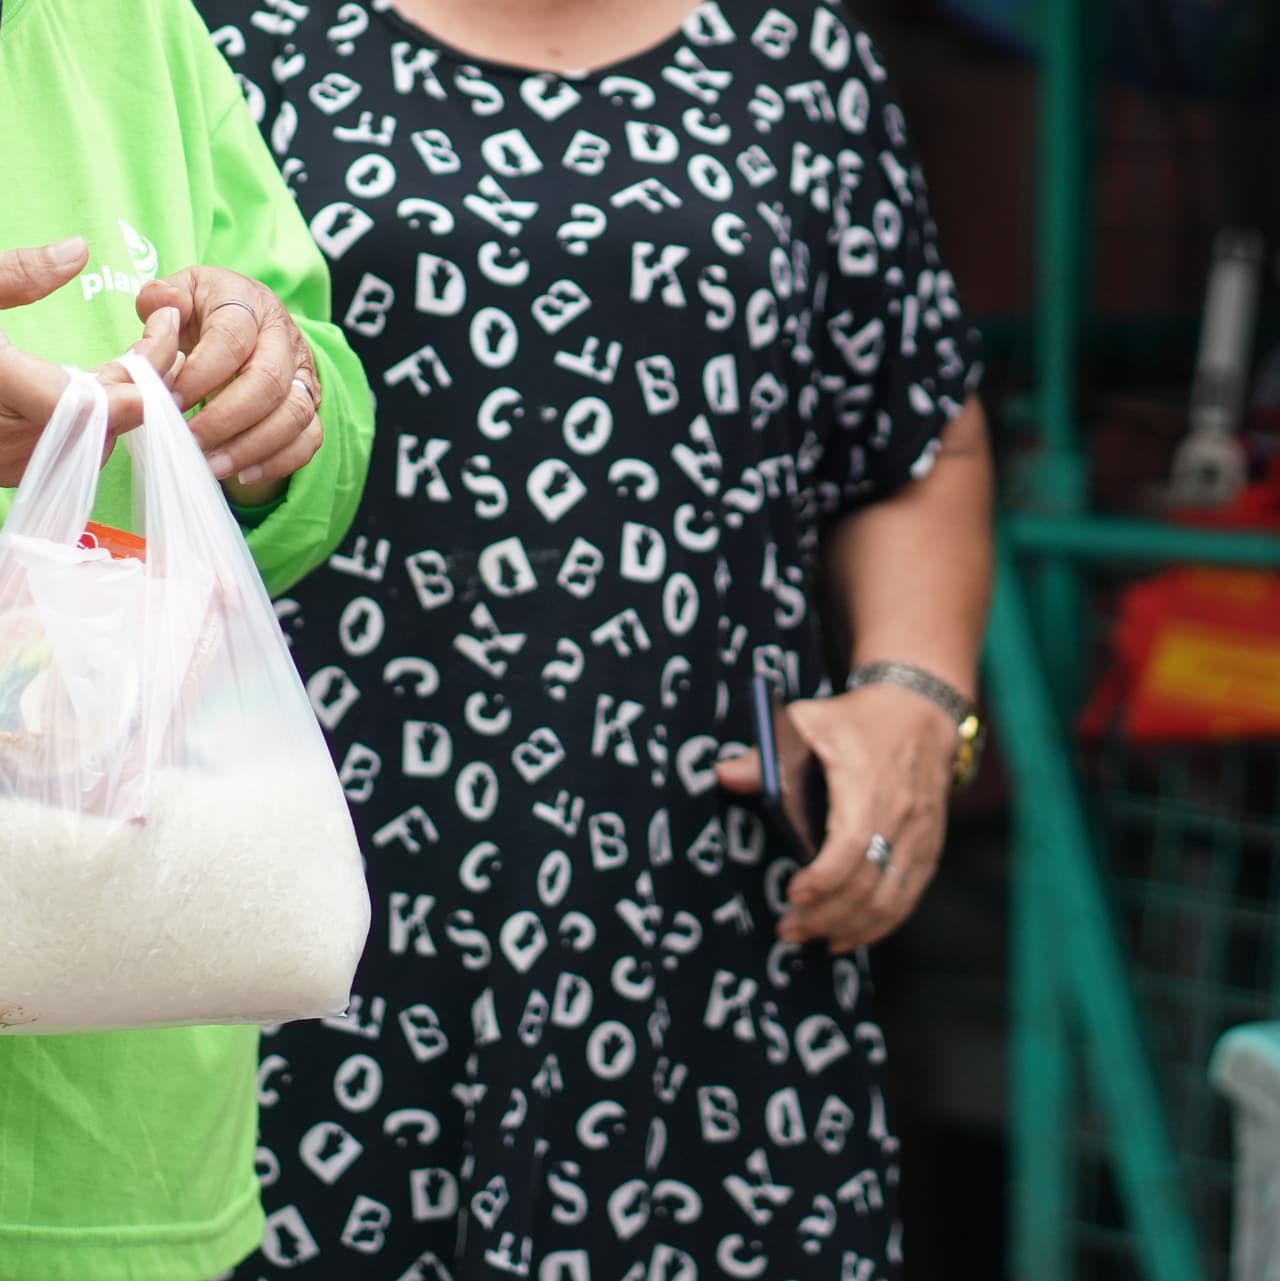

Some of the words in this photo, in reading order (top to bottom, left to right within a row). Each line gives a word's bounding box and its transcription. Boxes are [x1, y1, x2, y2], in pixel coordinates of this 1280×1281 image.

[751, 9, 798, 59] B
[810, 7, 850, 70] D
[308, 73, 362, 115] B
[390, 42, 447, 100] K
[455, 66, 503, 115] S
[599, 77, 655, 110] C
[661, 47, 732, 104] K
[682, 108, 731, 145] C
[785, 80, 836, 119] F
[410, 130, 461, 175] B
[481, 129, 543, 177] D
[561, 130, 610, 176] B
[625, 121, 679, 163] D
[736, 145, 777, 187] B
[345, 154, 396, 199] O
[609, 179, 683, 213] F
[687, 155, 732, 202] O
[396, 199, 454, 235] C
[462, 175, 539, 237] K
[711, 213, 746, 255] C
[415, 253, 465, 316] D
[477, 242, 529, 286] C
[630, 241, 689, 307] K
[344, 273, 394, 336] B
[531, 280, 591, 334] B
[698, 264, 735, 330] S
[470, 308, 518, 368] O
[383, 346, 452, 395] F
[635, 355, 679, 415] B
[703, 355, 739, 413] D
[477, 388, 522, 440] C
[563, 397, 613, 455] O
[396, 435, 451, 501] K
[461, 454, 508, 518] S
[526, 460, 587, 522] D
[608, 459, 658, 501] C
[620, 522, 665, 582] D
[674, 504, 719, 551] C
[405, 551, 454, 609] B
[478, 537, 538, 597] D
[557, 537, 604, 598] B
[339, 597, 385, 655] O
[662, 573, 699, 634] O
[591, 609, 651, 655] F
[383, 657, 439, 696] C
[465, 692, 511, 735] C
[592, 694, 643, 765] K
[402, 721, 452, 777] D
[512, 728, 565, 782] B
[455, 762, 498, 821] O
[373, 806, 438, 851] F
[589, 812, 628, 869] B
[459, 842, 498, 892] C
[537, 850, 571, 905] O
[389, 893, 436, 955] K
[446, 909, 491, 969] S
[500, 911, 547, 972] D
[559, 912, 595, 950] C
[551, 973, 592, 1027] D
[612, 957, 654, 999] C
[399, 1011, 447, 1061] B
[587, 1021, 635, 1078] O
[796, 1016, 847, 1071] D
[334, 1055, 382, 1111] O
[384, 1110, 438, 1143] C
[577, 1101, 624, 1148] C
[697, 1086, 740, 1142] B
[766, 1088, 806, 1143] D
[300, 1123, 362, 1183] D
[411, 1169, 456, 1220] D
[547, 1160, 587, 1223] S
[653, 1181, 701, 1222] C
[259, 1205, 318, 1266] D
[341, 1196, 390, 1252] B
[718, 1235, 765, 1277] C
